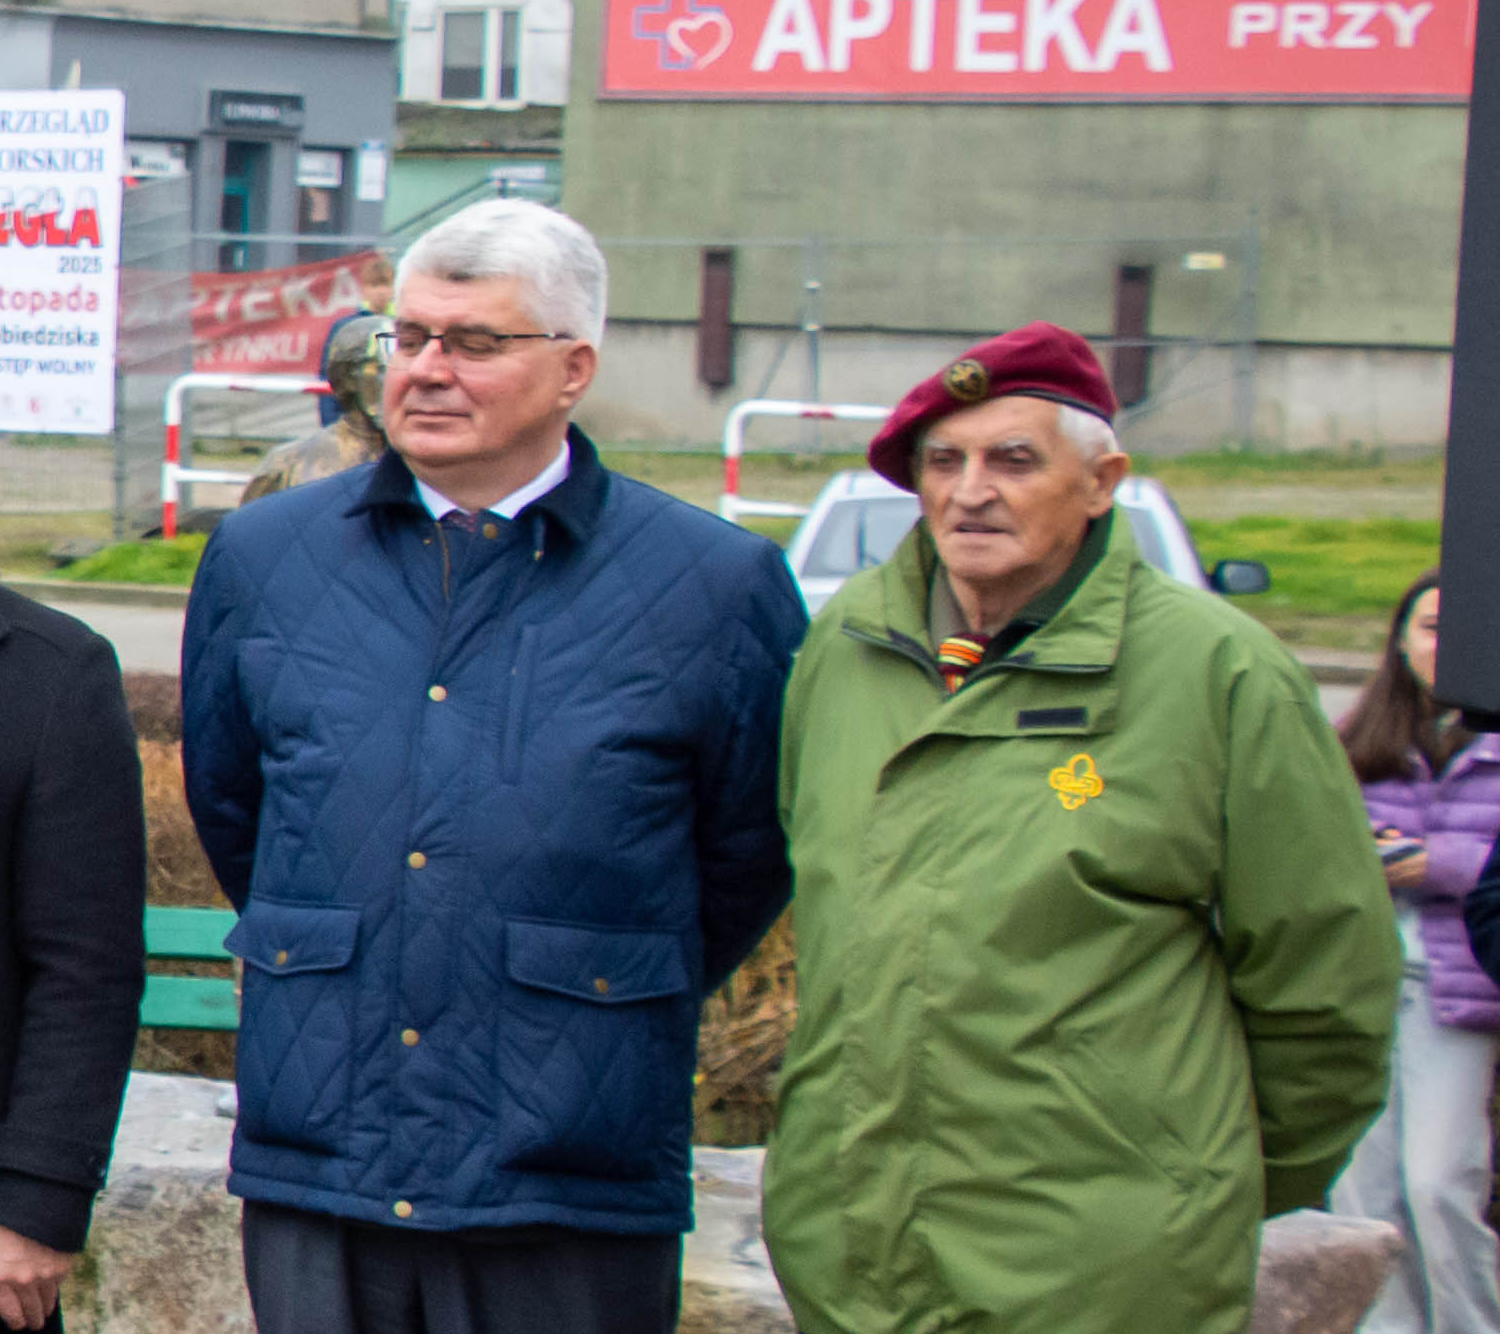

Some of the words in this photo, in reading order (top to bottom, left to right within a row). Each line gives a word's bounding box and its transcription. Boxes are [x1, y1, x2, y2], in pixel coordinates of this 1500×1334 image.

[1227, 1, 1435, 48] PRZY
[58, 255, 102, 274] 2025
[38, 358, 96, 374] WOLNY
